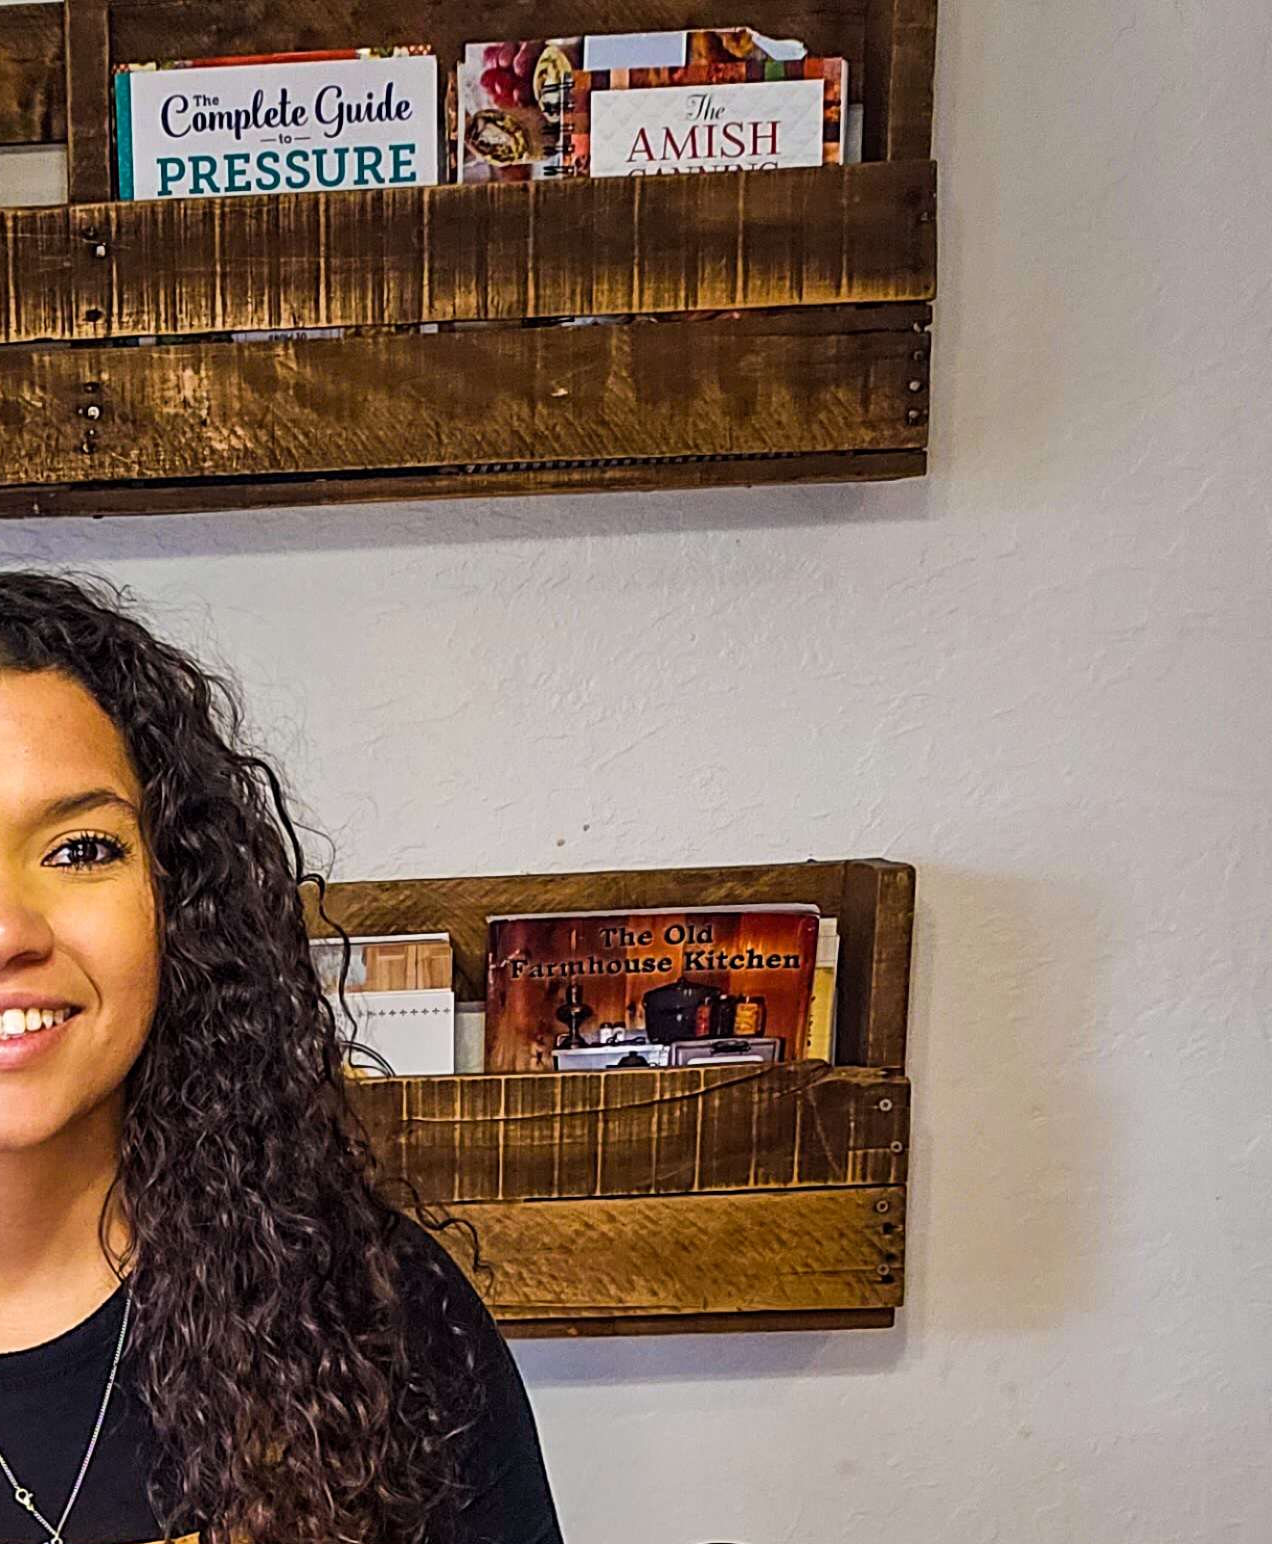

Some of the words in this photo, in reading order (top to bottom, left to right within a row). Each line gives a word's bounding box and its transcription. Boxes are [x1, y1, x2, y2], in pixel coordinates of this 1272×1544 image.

[160, 88, 309, 141] Complete
[315, 81, 413, 139] Guide
[192, 94, 220, 108] The
[685, 93, 726, 122] The
[278, 133, 292, 145] to
[626, 120, 782, 163] AMISH
[156, 143, 418, 197] PRESSURE
[599, 926, 653, 948] The
[664, 924, 713, 946] Old
[510, 956, 673, 979] Farmhouse
[683, 950, 802, 972] Kitchen
